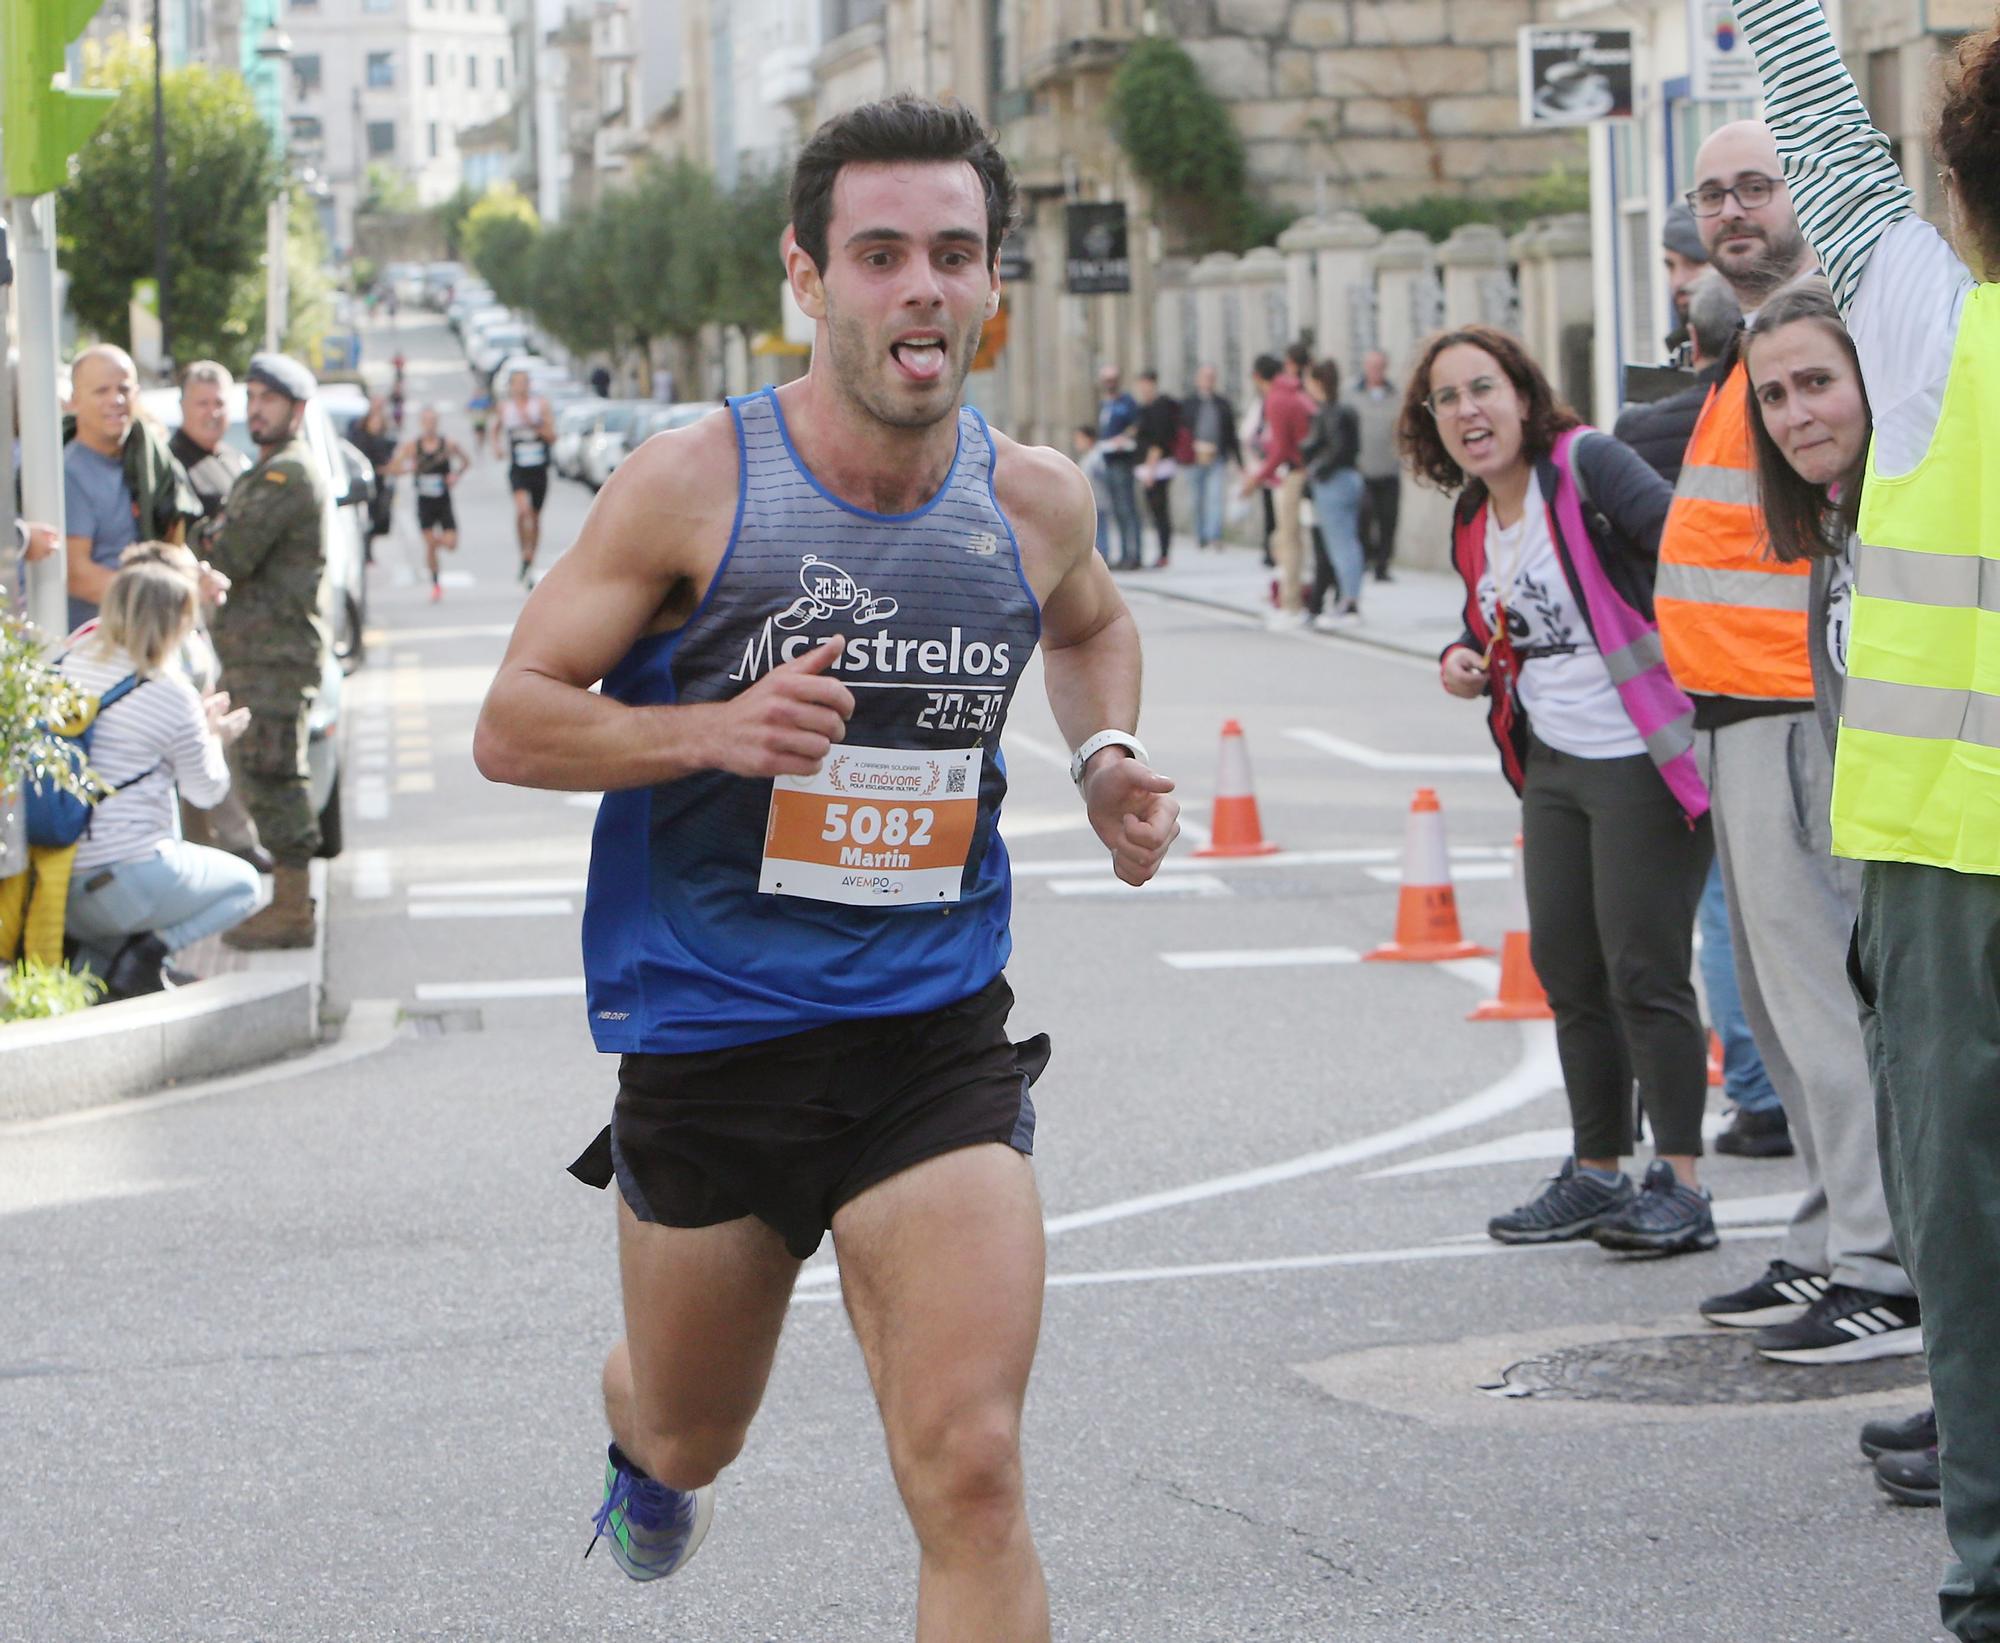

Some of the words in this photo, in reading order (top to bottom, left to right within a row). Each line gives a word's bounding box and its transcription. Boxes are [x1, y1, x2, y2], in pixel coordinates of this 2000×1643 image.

[814, 577, 851, 600] 20:30
[916, 692, 1003, 732] 20:30
[849, 772, 866, 783] EU
[870, 771, 922, 786] MÓVOME
[821, 803, 934, 846] 5082
[842, 876, 890, 888] AVEMPO
